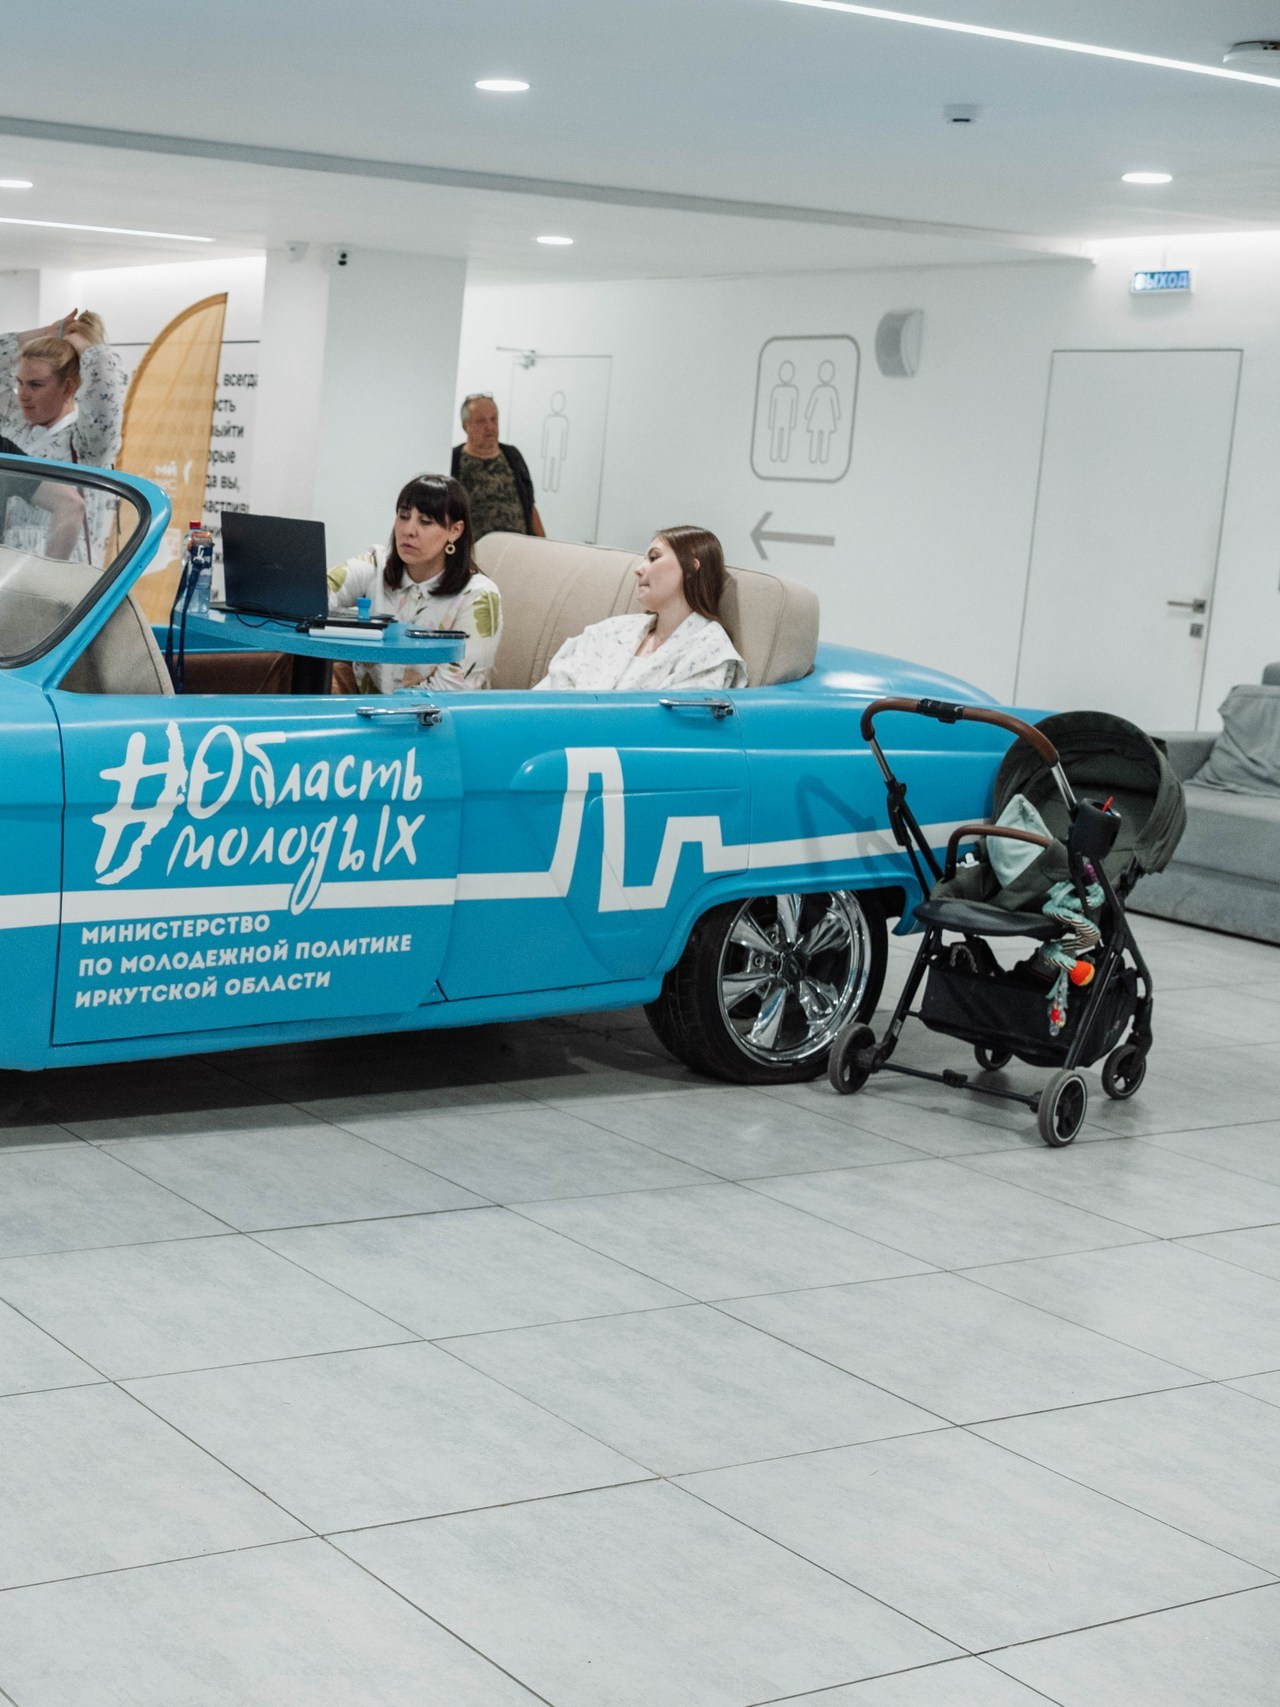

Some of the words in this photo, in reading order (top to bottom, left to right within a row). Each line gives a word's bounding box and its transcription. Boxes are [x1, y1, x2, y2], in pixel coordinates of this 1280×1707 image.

[1135, 271, 1189, 290] ВЫХОД
[167, 804, 426, 915] молодых
[81, 913, 271, 945] МИНИСТЕРСТВО
[78, 957, 113, 977] ПО
[120, 938, 289, 974] МОЛОДЕЖНОЙ
[294, 934, 413, 960] ПОЛИТИКЕ
[74, 975, 218, 1008] ИРКУТСКОЙ
[224, 970, 332, 997] ОБЛАСТИ
